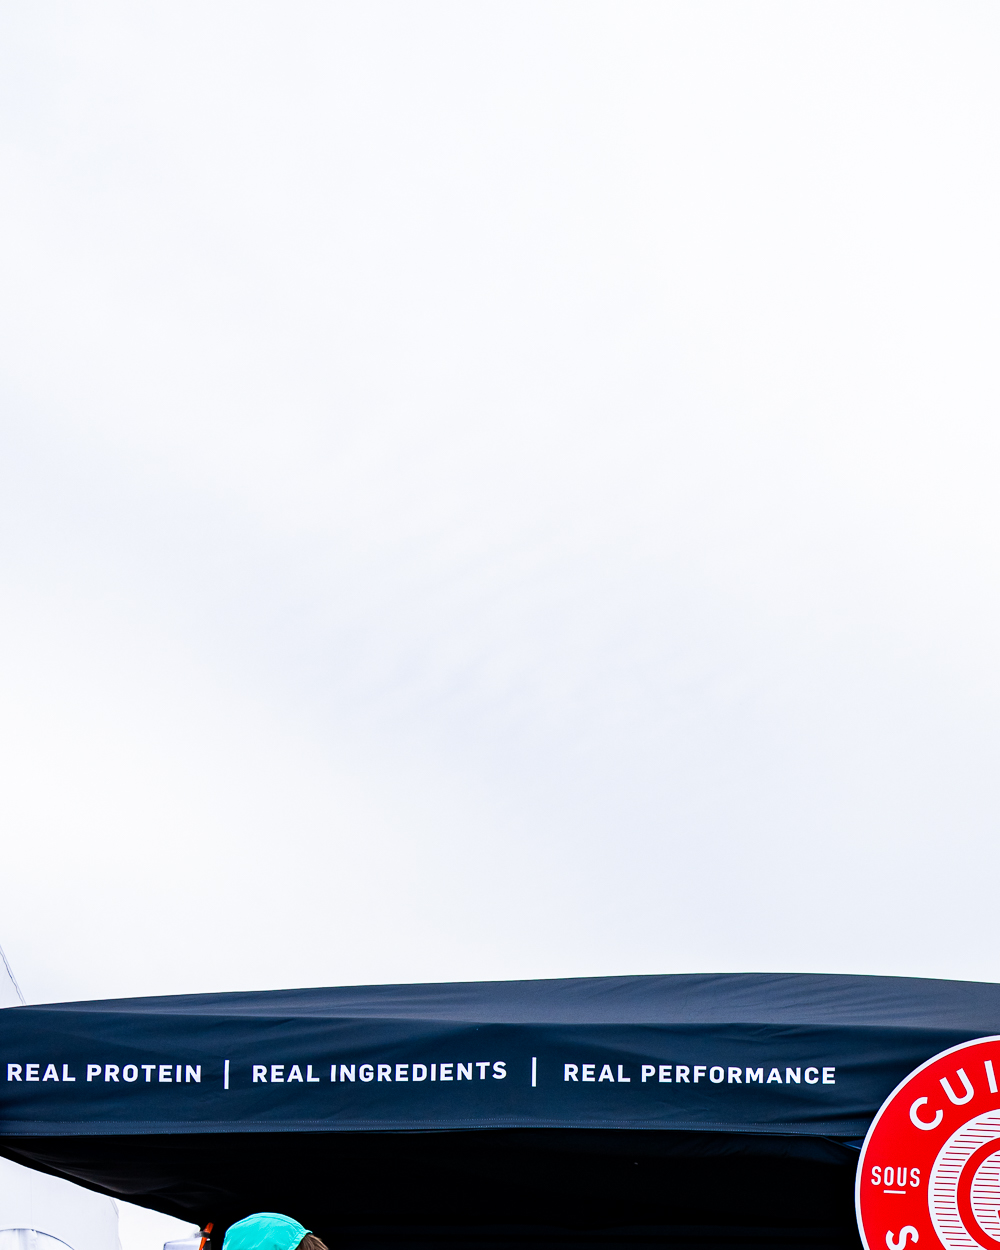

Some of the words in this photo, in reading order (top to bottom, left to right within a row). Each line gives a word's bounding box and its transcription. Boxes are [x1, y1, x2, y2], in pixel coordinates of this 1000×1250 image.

[7, 1062, 76, 1083] REAL
[86, 1063, 202, 1084] PROTEIN
[252, 1064, 320, 1083] REAL
[330, 1060, 508, 1083] INGREDIENTS
[563, 1062, 632, 1083] REAL
[641, 1064, 837, 1085] PERFORMANCE
[870, 1165, 921, 1188] SOUS
